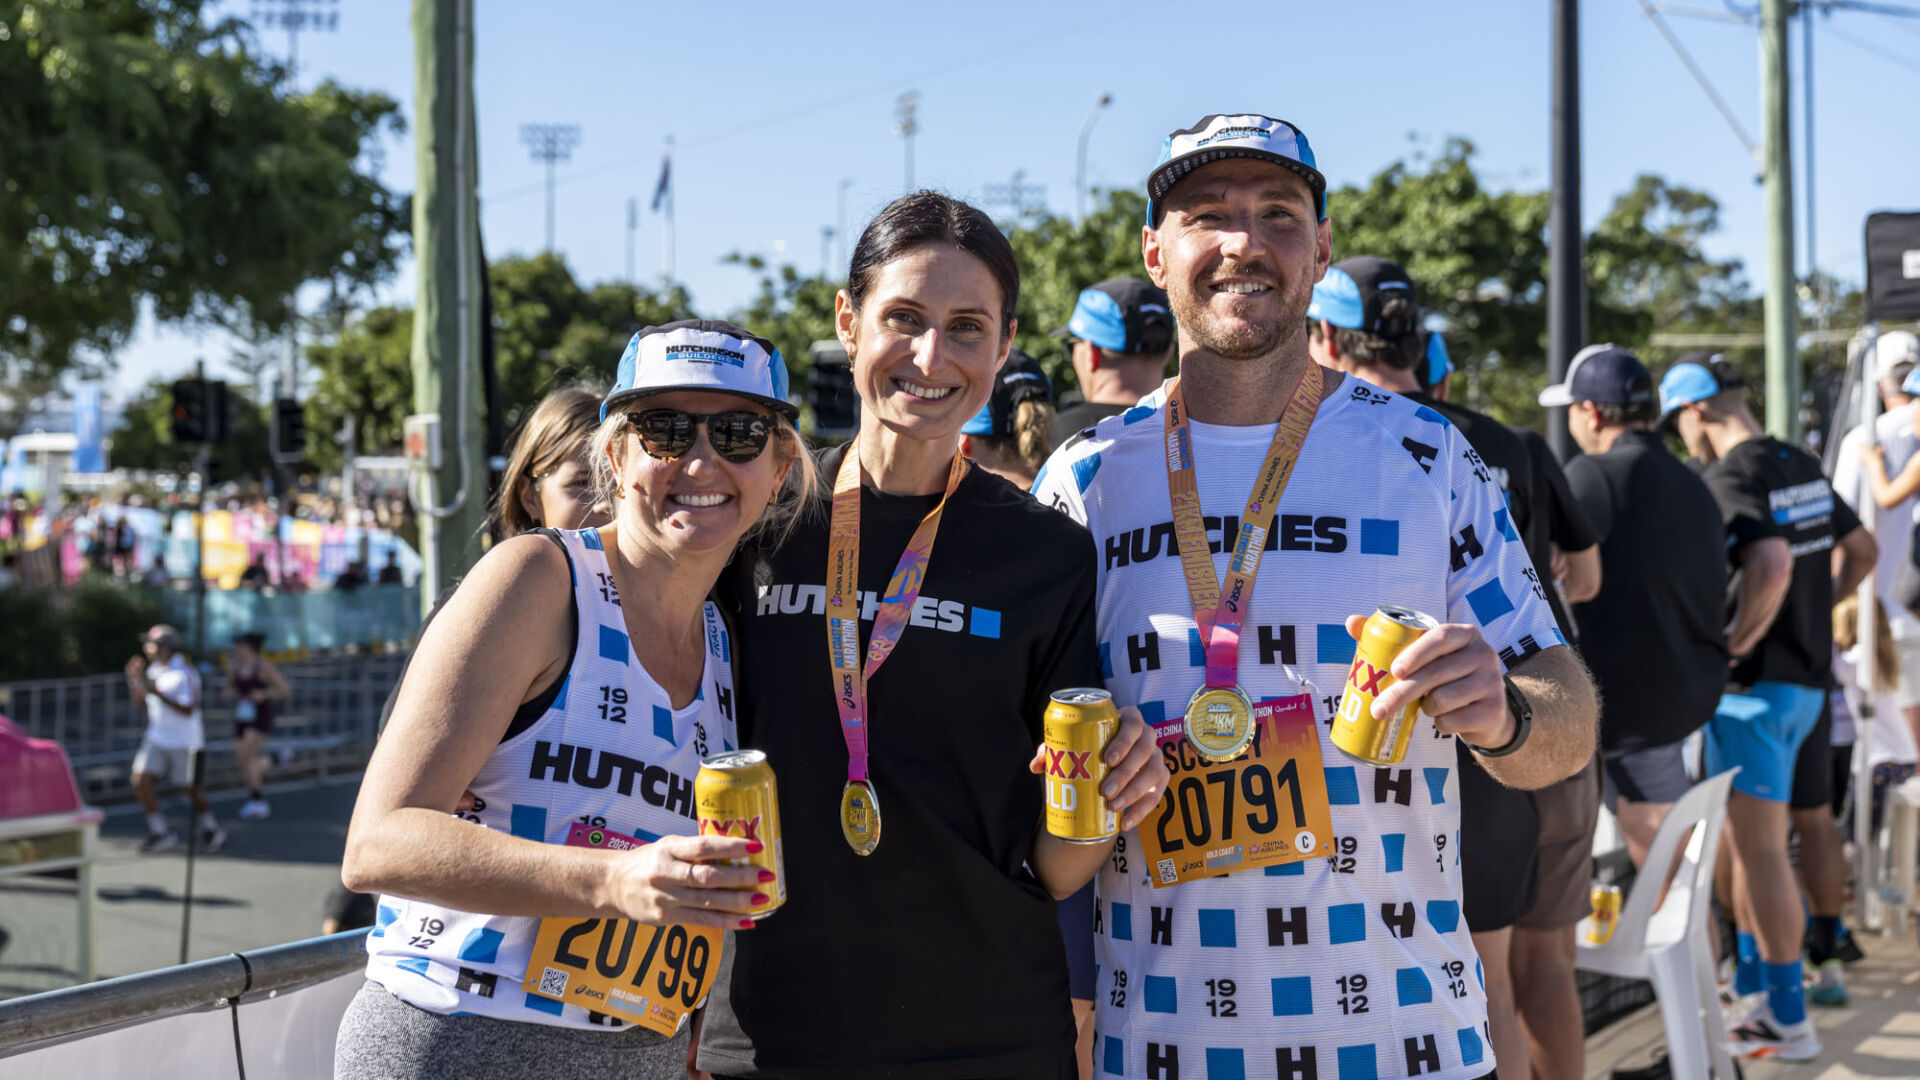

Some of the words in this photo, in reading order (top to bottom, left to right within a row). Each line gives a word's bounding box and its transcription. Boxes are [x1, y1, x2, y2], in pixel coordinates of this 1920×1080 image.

[666, 345, 745, 362] HUTCHINSON
[1241, 525, 1267, 577] MARATHON
[1230, 578, 1244, 602] asics
[841, 619, 858, 668] MARATHON
[1127, 632, 1161, 673] H
[1257, 625, 1297, 665] H
[599, 686, 628, 704] 19
[843, 674, 853, 697] asics
[715, 681, 733, 721] H
[598, 704, 627, 724] 12
[1164, 723, 1182, 736] CHINA
[1374, 767, 1412, 806] H
[1156, 758, 1307, 854] 20791
[1302, 836, 1309, 848] C
[1112, 856, 1128, 873] 12
[419, 916, 445, 936] 19
[1151, 906, 1173, 946] H
[1266, 907, 1308, 947] H
[1381, 902, 1416, 938] H
[408, 935, 434, 950] 12
[1113, 969, 1127, 988] 19
[1441, 960, 1464, 979] 19
[1205, 979, 1237, 997] 19
[1336, 974, 1368, 994] 19
[1449, 979, 1468, 999] 12
[585, 989, 605, 1000] asics
[1110, 989, 1126, 1008] 12
[1206, 999, 1238, 1017] 12
[1337, 995, 1369, 1015] 12
[1146, 1042, 1179, 1080] H
[1275, 1047, 1318, 1080] H
[1404, 1034, 1440, 1077] H
